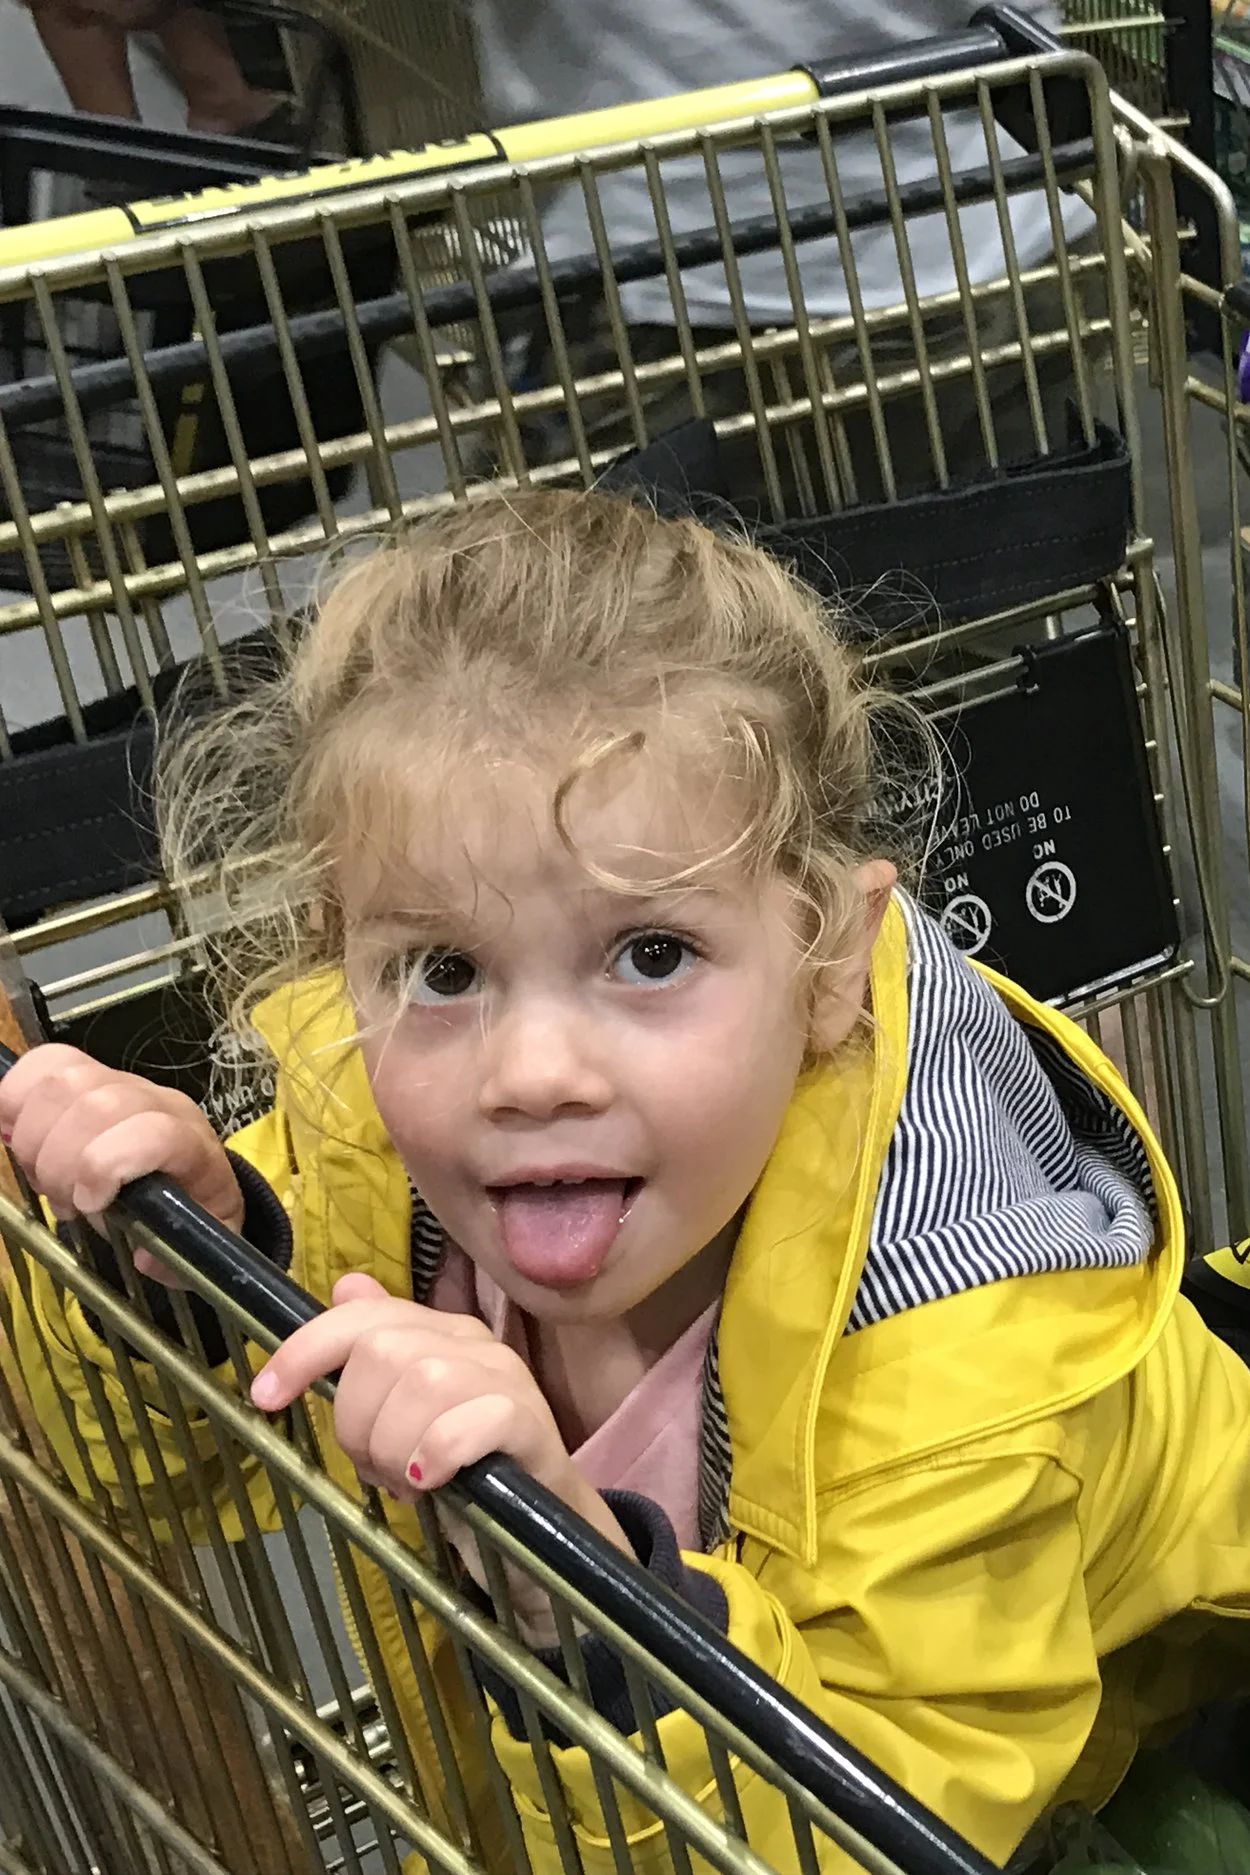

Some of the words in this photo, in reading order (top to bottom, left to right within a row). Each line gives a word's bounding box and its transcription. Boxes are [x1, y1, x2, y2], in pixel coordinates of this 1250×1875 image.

[986, 800, 1015, 826] NOT
[1019, 791, 1040, 813] DO
[1027, 812, 1047, 834] BE
[1053, 805, 1072, 824] TO
[981, 822, 1022, 851] USED
[936, 840, 975, 869] ONLY
[1032, 839, 1056, 860] NO
[944, 872, 969, 893] NO
